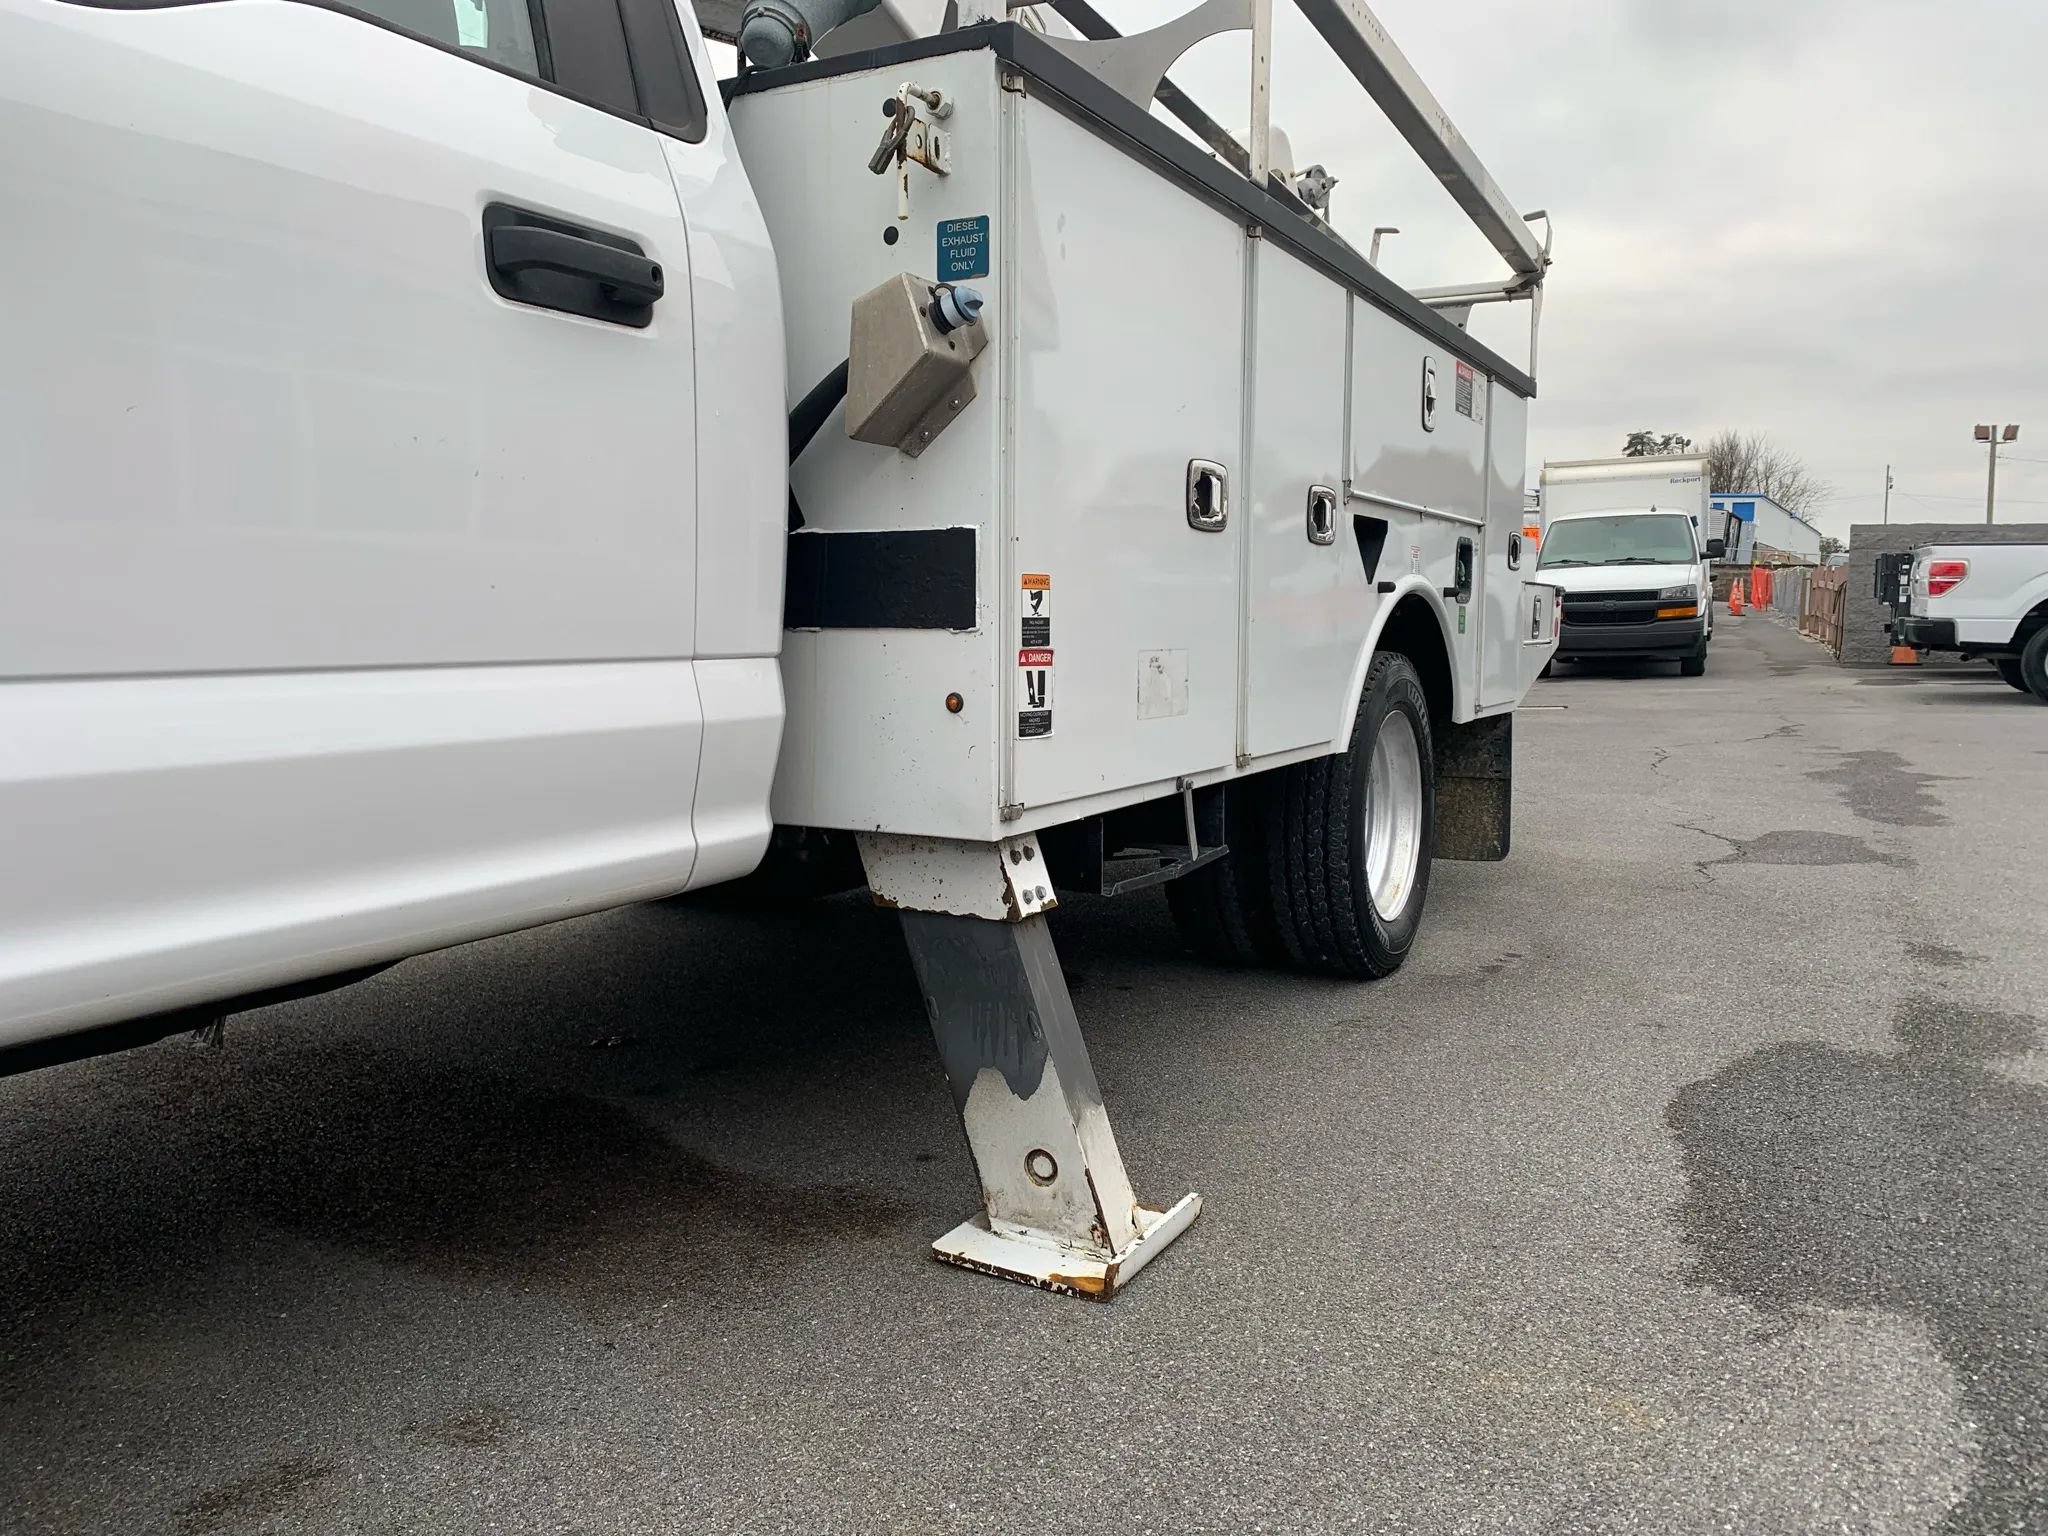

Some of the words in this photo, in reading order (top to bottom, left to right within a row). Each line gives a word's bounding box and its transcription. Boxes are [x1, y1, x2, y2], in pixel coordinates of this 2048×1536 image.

[947, 221, 979, 233] DIESEL
[942, 233, 984, 247] EXHAUST
[950, 248, 976, 259] FLUID
[951, 260, 975, 271] ONLY
[1028, 578, 1049, 586] WARNING
[1028, 653, 1052, 663] DANGER
